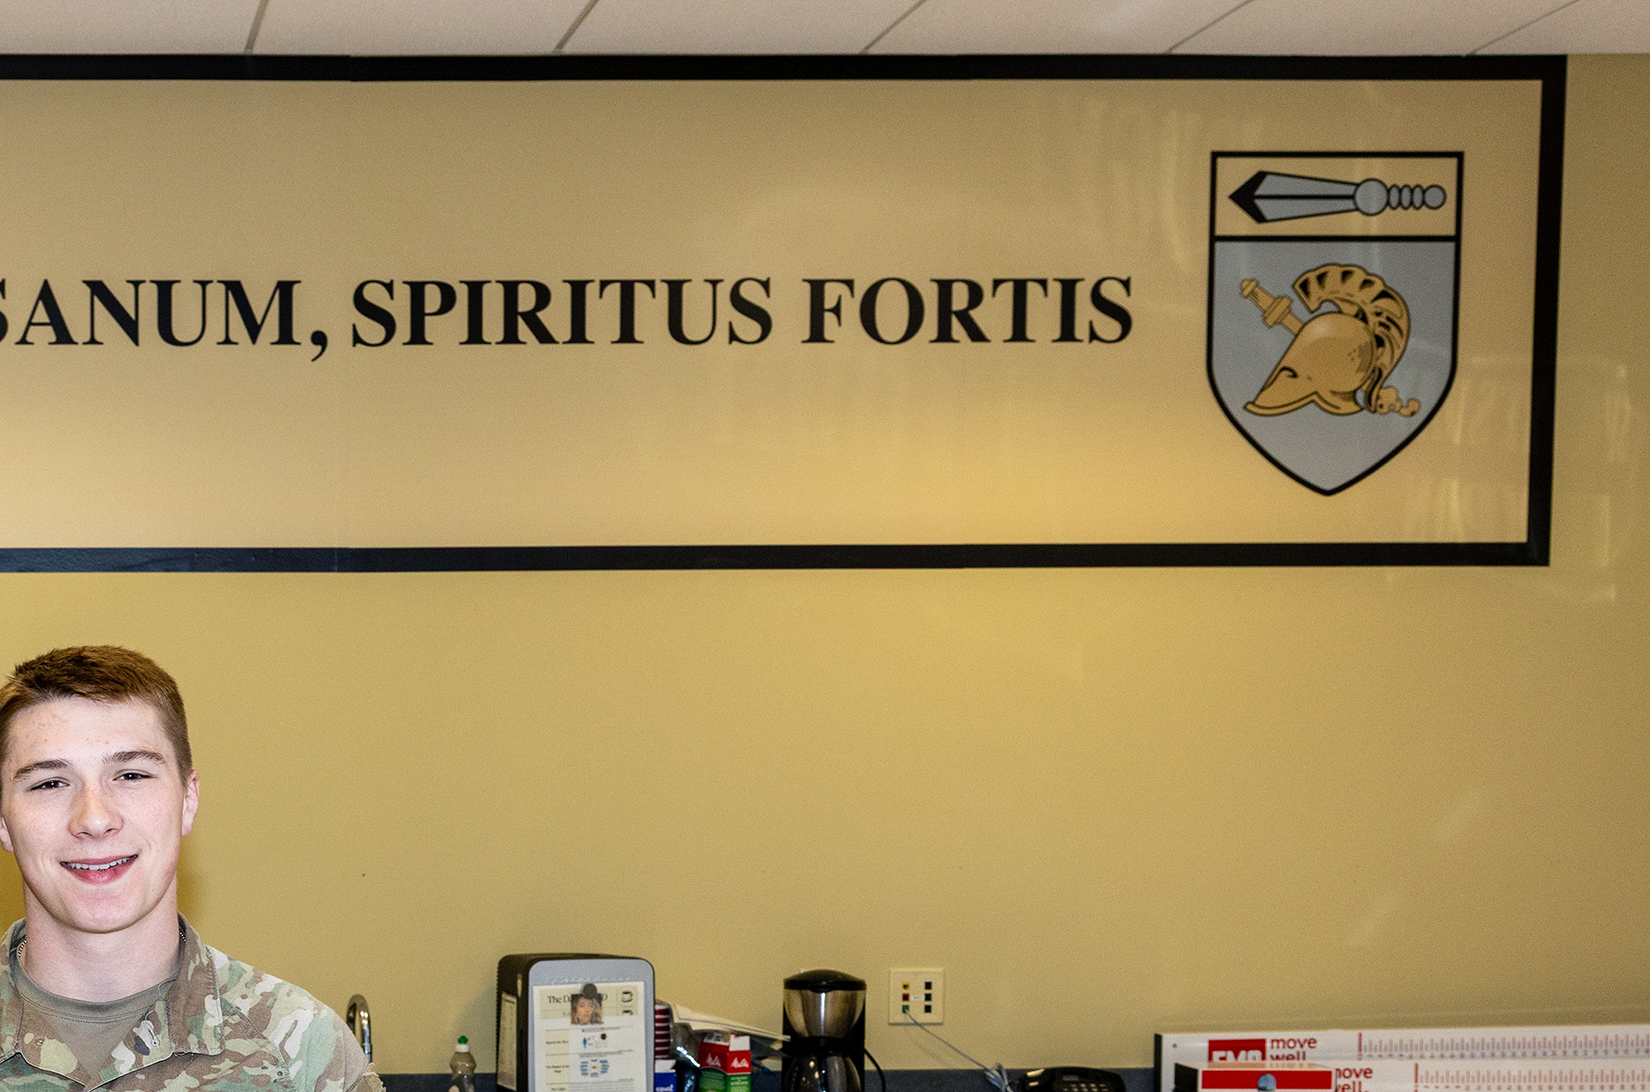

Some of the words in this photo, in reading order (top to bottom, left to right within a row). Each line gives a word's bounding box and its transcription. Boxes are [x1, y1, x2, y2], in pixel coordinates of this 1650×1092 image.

[350, 276, 774, 348] SPIRITUS
[800, 275, 1135, 346] FORTIS
[1270, 1038, 1317, 1049] move
